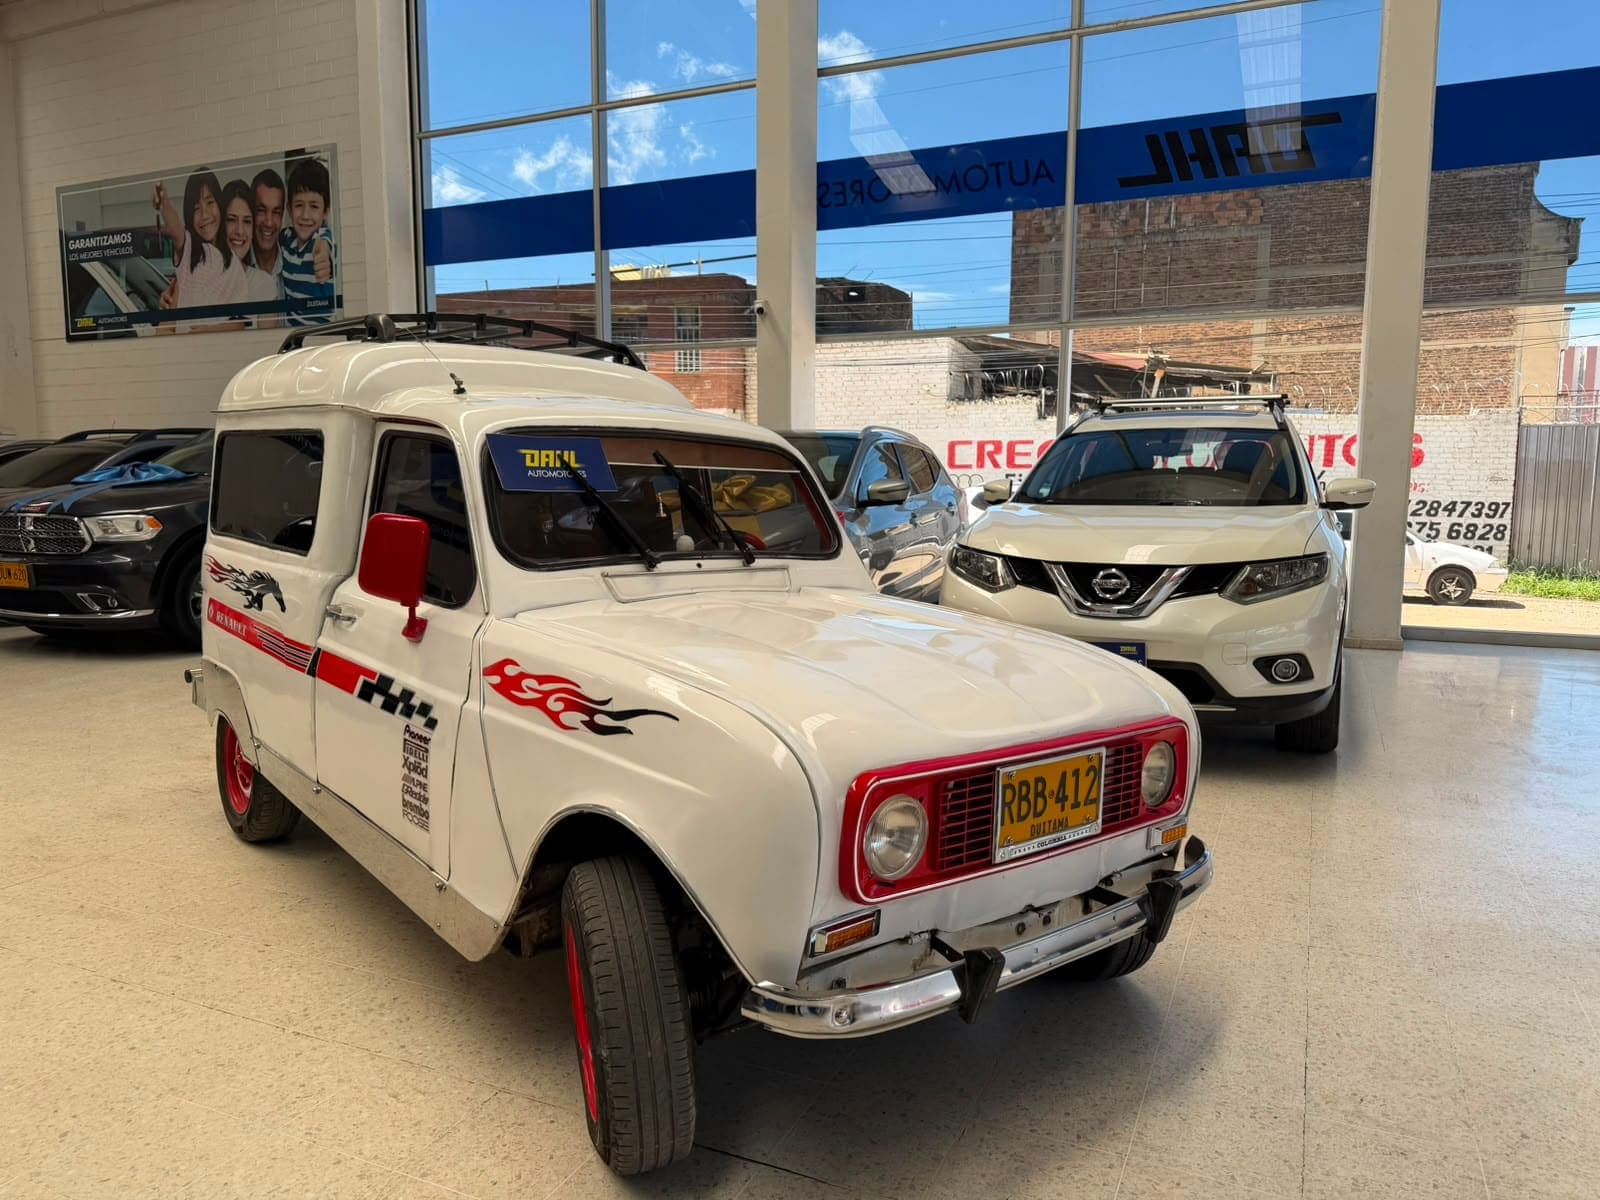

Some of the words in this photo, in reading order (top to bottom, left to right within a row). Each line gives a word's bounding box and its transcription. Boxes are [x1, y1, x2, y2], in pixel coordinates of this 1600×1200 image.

[69, 233, 132, 249] GARANTIZAMOS
[527, 470, 587, 478] AUTOMOTOES
[1408, 500, 1511, 518] 2847397
[1447, 523, 1507, 540] 6828
[216, 611, 247, 636] RENAULT
[404, 724, 431, 745] Pioneer
[1000, 776, 1048, 826] RBB
[1055, 765, 1097, 812] 412
